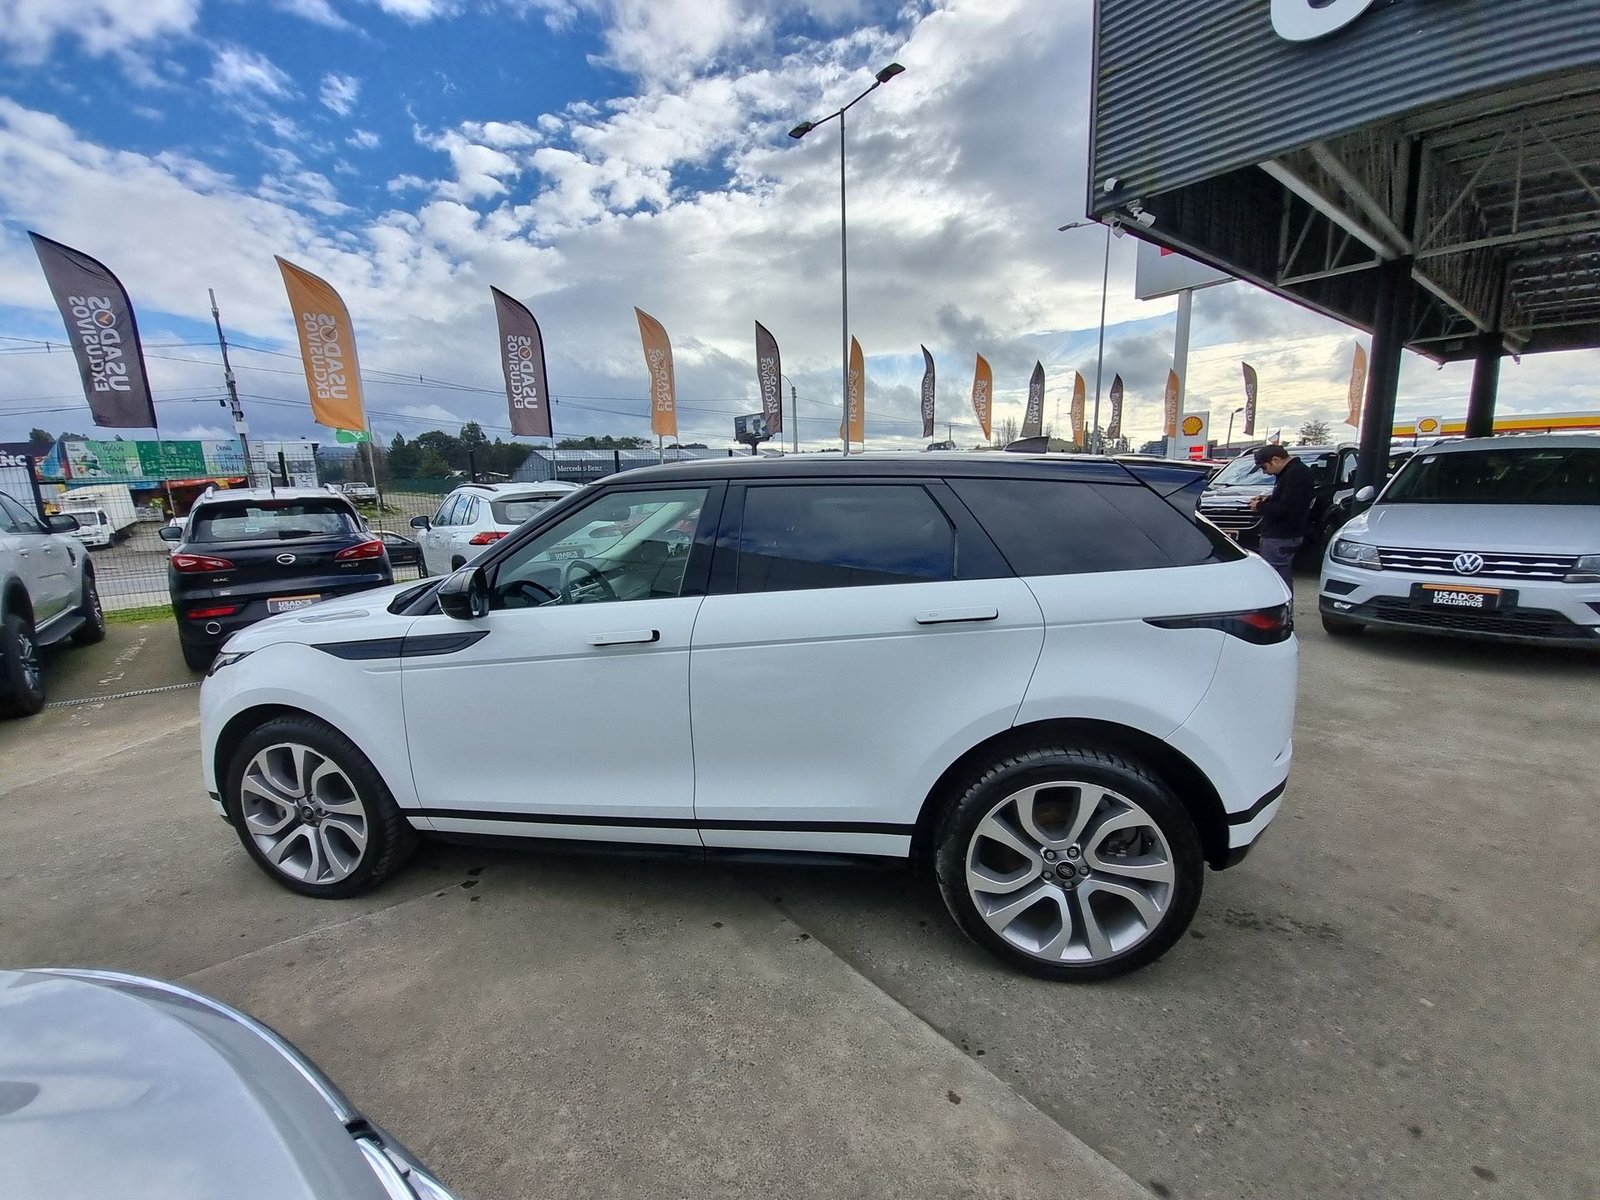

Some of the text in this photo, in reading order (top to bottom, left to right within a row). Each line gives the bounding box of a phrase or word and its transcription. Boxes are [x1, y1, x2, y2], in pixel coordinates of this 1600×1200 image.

[557, 464, 603, 473] Mercedes-Benz
[1434, 591, 1484, 602] USADOS
[278, 598, 313, 607] USADOS
[1433, 598, 1483, 608] EXCLUSIVOS
